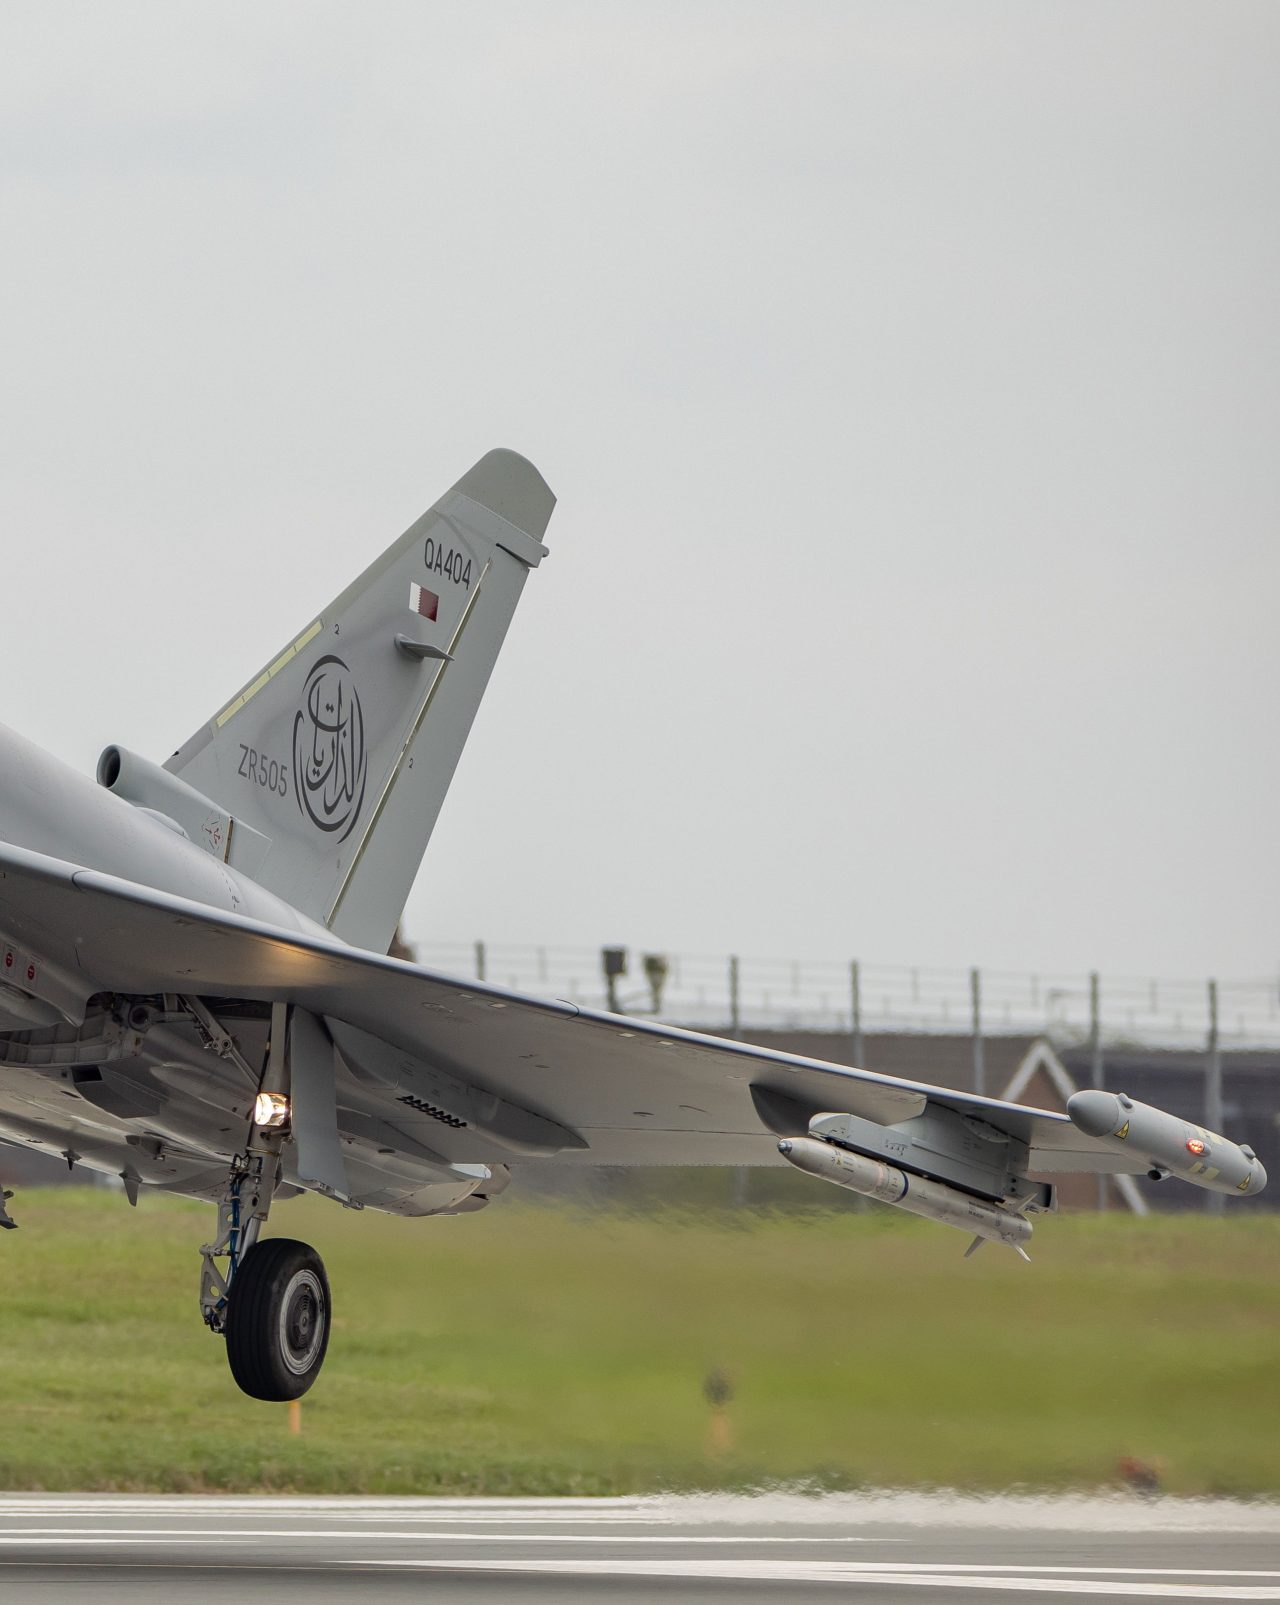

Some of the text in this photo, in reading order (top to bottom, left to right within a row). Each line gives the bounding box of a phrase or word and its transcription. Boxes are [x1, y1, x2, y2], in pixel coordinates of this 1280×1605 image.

[424, 537, 472, 590] QA404
[334, 623, 340, 635] 2
[238, 743, 288, 797] ZR505
